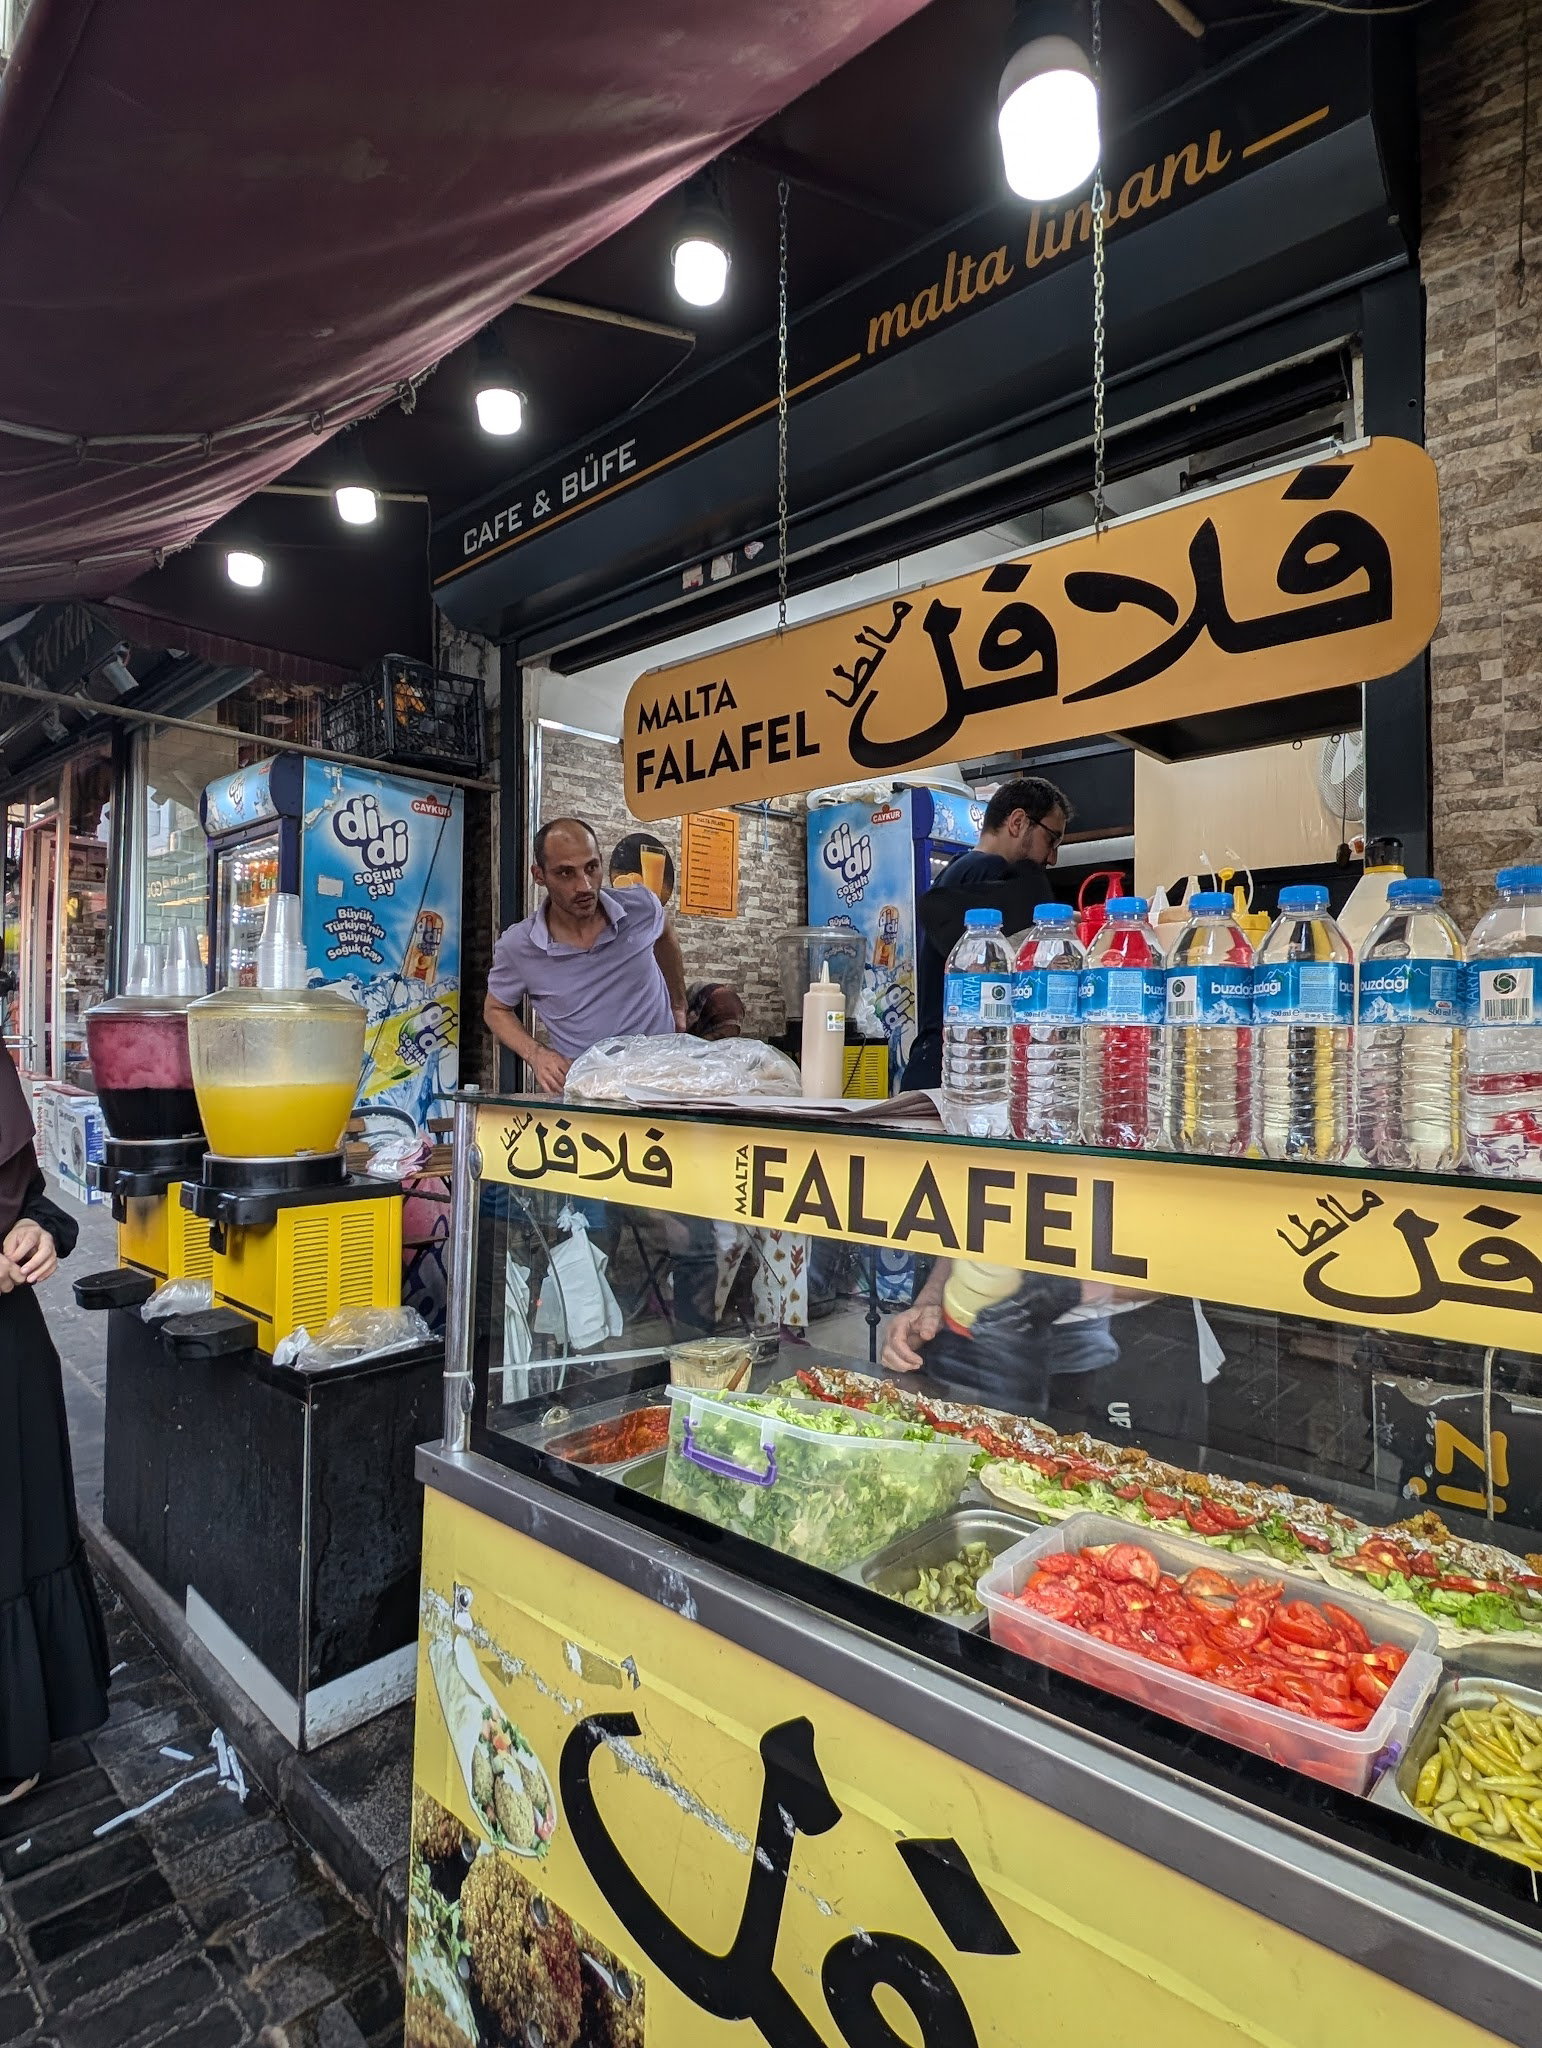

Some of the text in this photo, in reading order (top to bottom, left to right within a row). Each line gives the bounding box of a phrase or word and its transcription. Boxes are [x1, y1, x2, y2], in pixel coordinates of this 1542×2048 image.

[867, 250, 1014, 354] malta
[463, 438, 637, 555] CAFE & BÜFE
[848, 464, 1393, 770] فلافل
[637, 678, 738, 735] MALTA
[636, 710, 820, 794] FALAFEL
[338, 908, 373, 921] Büyük
[368, 882, 394, 900] çay
[325, 919, 385, 939] Türkiye'nin
[328, 944, 361, 959] Soğuk
[338, 931, 373, 944] Büyük
[507, 1118, 673, 1188] فلافل
[734, 1145, 749, 1215] MALTA
[750, 1145, 1148, 1280] FALAFEL
